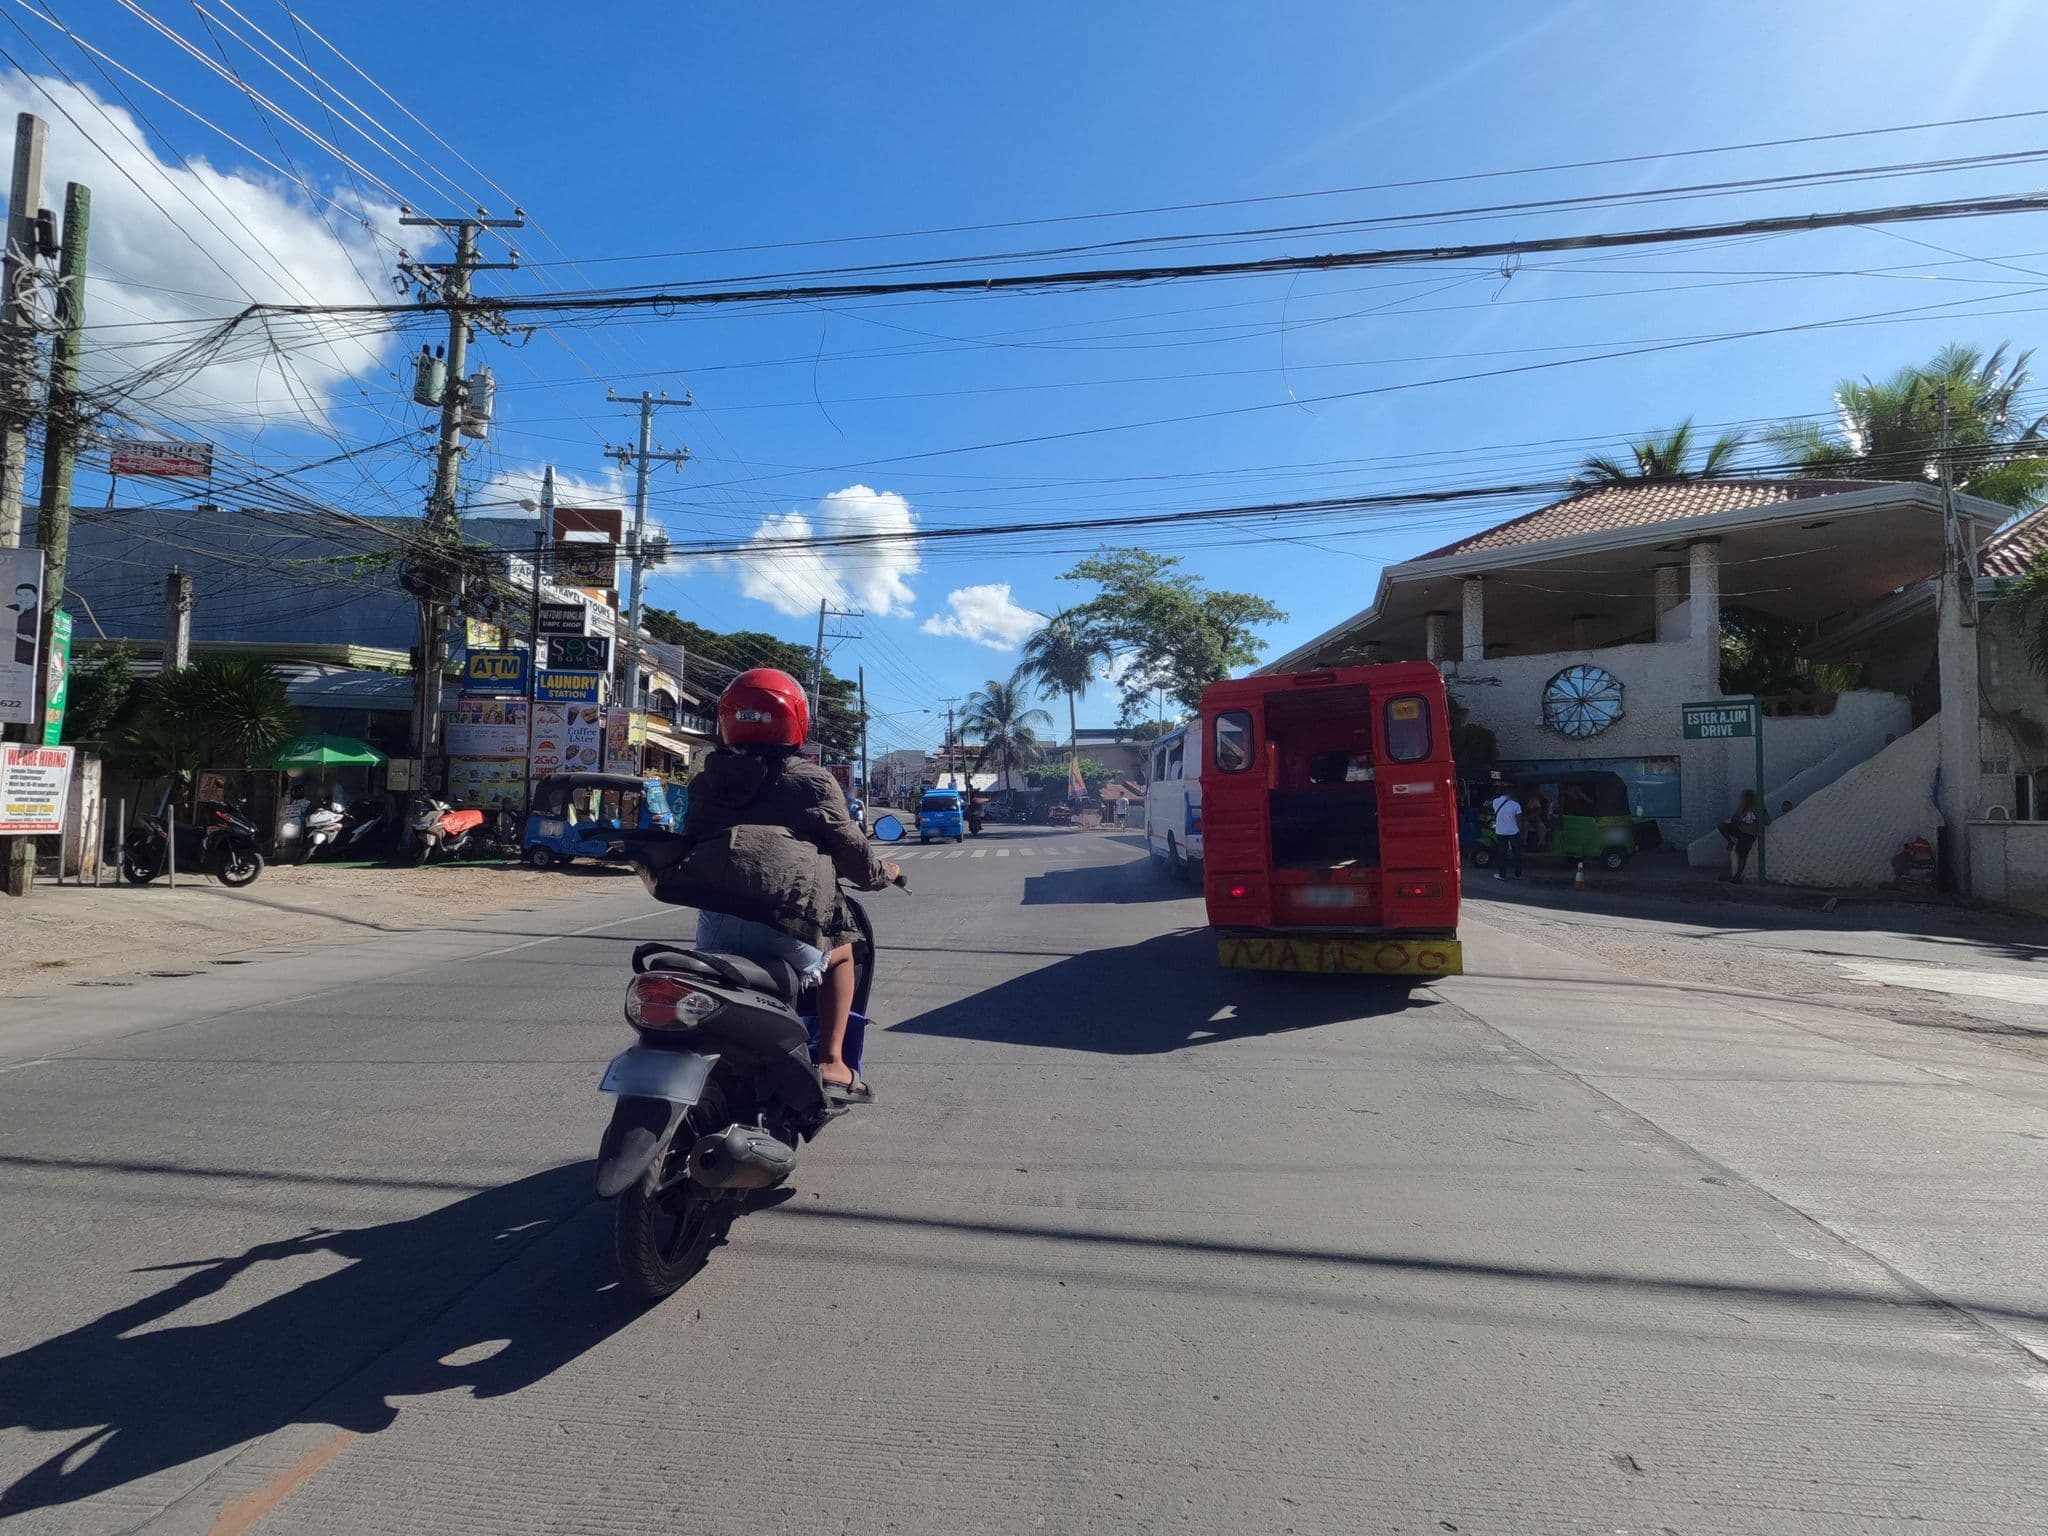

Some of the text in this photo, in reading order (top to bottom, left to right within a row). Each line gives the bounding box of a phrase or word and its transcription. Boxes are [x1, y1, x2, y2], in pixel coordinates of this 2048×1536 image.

[588, 599, 610, 618] TOURS
[473, 658, 519, 674] ATM
[540, 674, 597, 690] LAUNDRY
[548, 689, 588, 699] STATION
[1688, 711, 1718, 725] ESTER
[568, 727, 598, 736] Coffee
[1701, 724, 1734, 737] DRIVE
[8, 749, 67, 768] WE ARE HIRING
